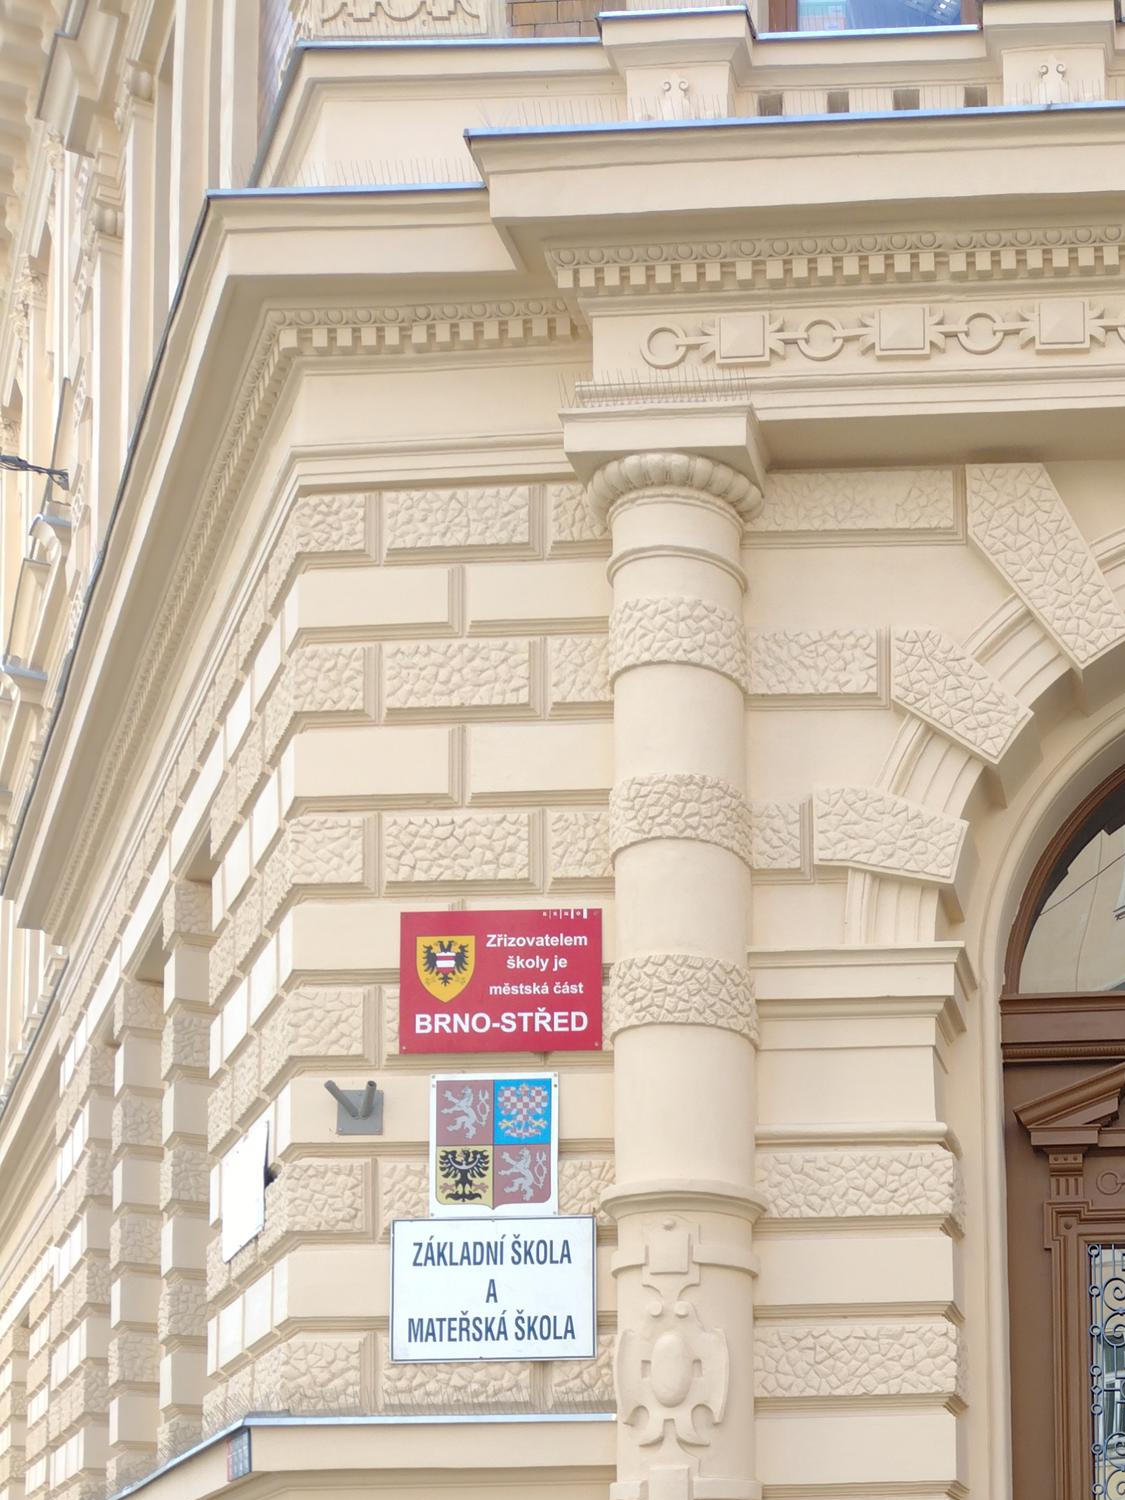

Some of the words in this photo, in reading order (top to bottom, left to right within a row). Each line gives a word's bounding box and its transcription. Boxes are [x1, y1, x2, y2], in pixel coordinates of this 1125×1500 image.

[486, 933, 588, 948] Zřizovatelem
[506, 955, 549, 972] školy
[552, 955, 568, 972] je
[489, 982, 549, 995] městská
[553, 981, 584, 994] část
[415, 1007, 588, 1034] BRNO-STŘED
[412, 1234, 505, 1267] ZÁKLADNÍ
[510, 1233, 572, 1265] ŠKOLA
[485, 1278, 498, 1303] A
[407, 1309, 509, 1343] MATEŘSKÁ
[514, 1309, 576, 1341] ŠKOLA
